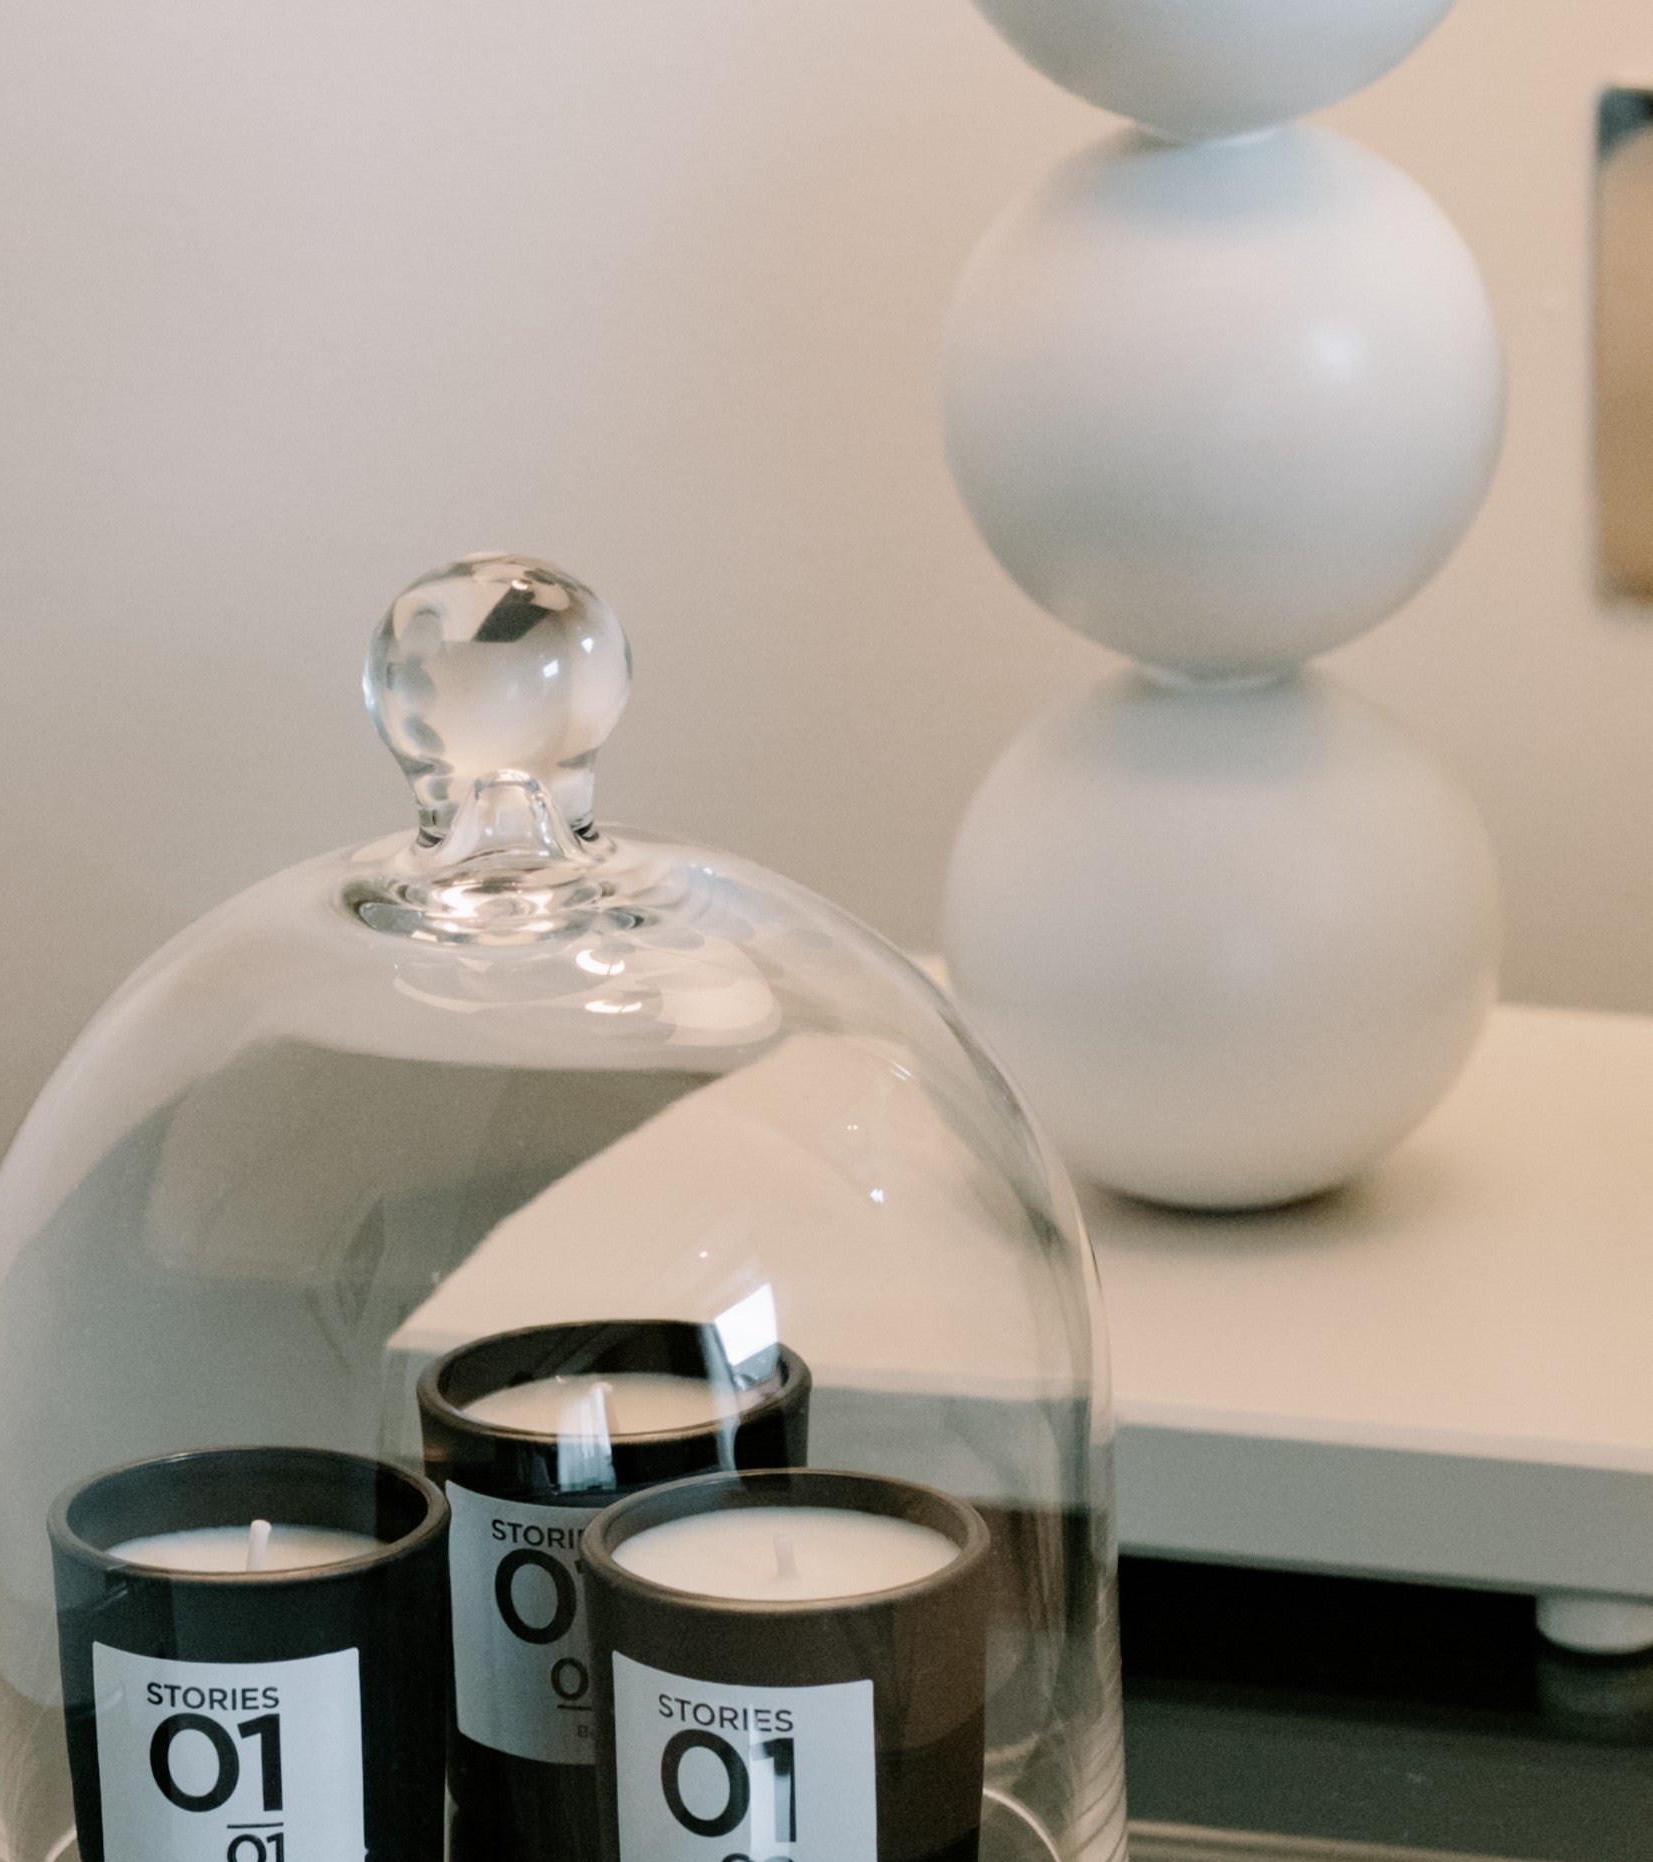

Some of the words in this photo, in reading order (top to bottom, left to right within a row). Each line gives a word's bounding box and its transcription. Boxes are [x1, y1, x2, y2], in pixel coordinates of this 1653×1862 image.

[495, 1548, 586, 1645] 0
[146, 1681, 280, 1711] STORIES
[658, 1693, 794, 1733] STORIES
[149, 1712, 284, 1813] 01
[660, 1728, 797, 1843] 01
